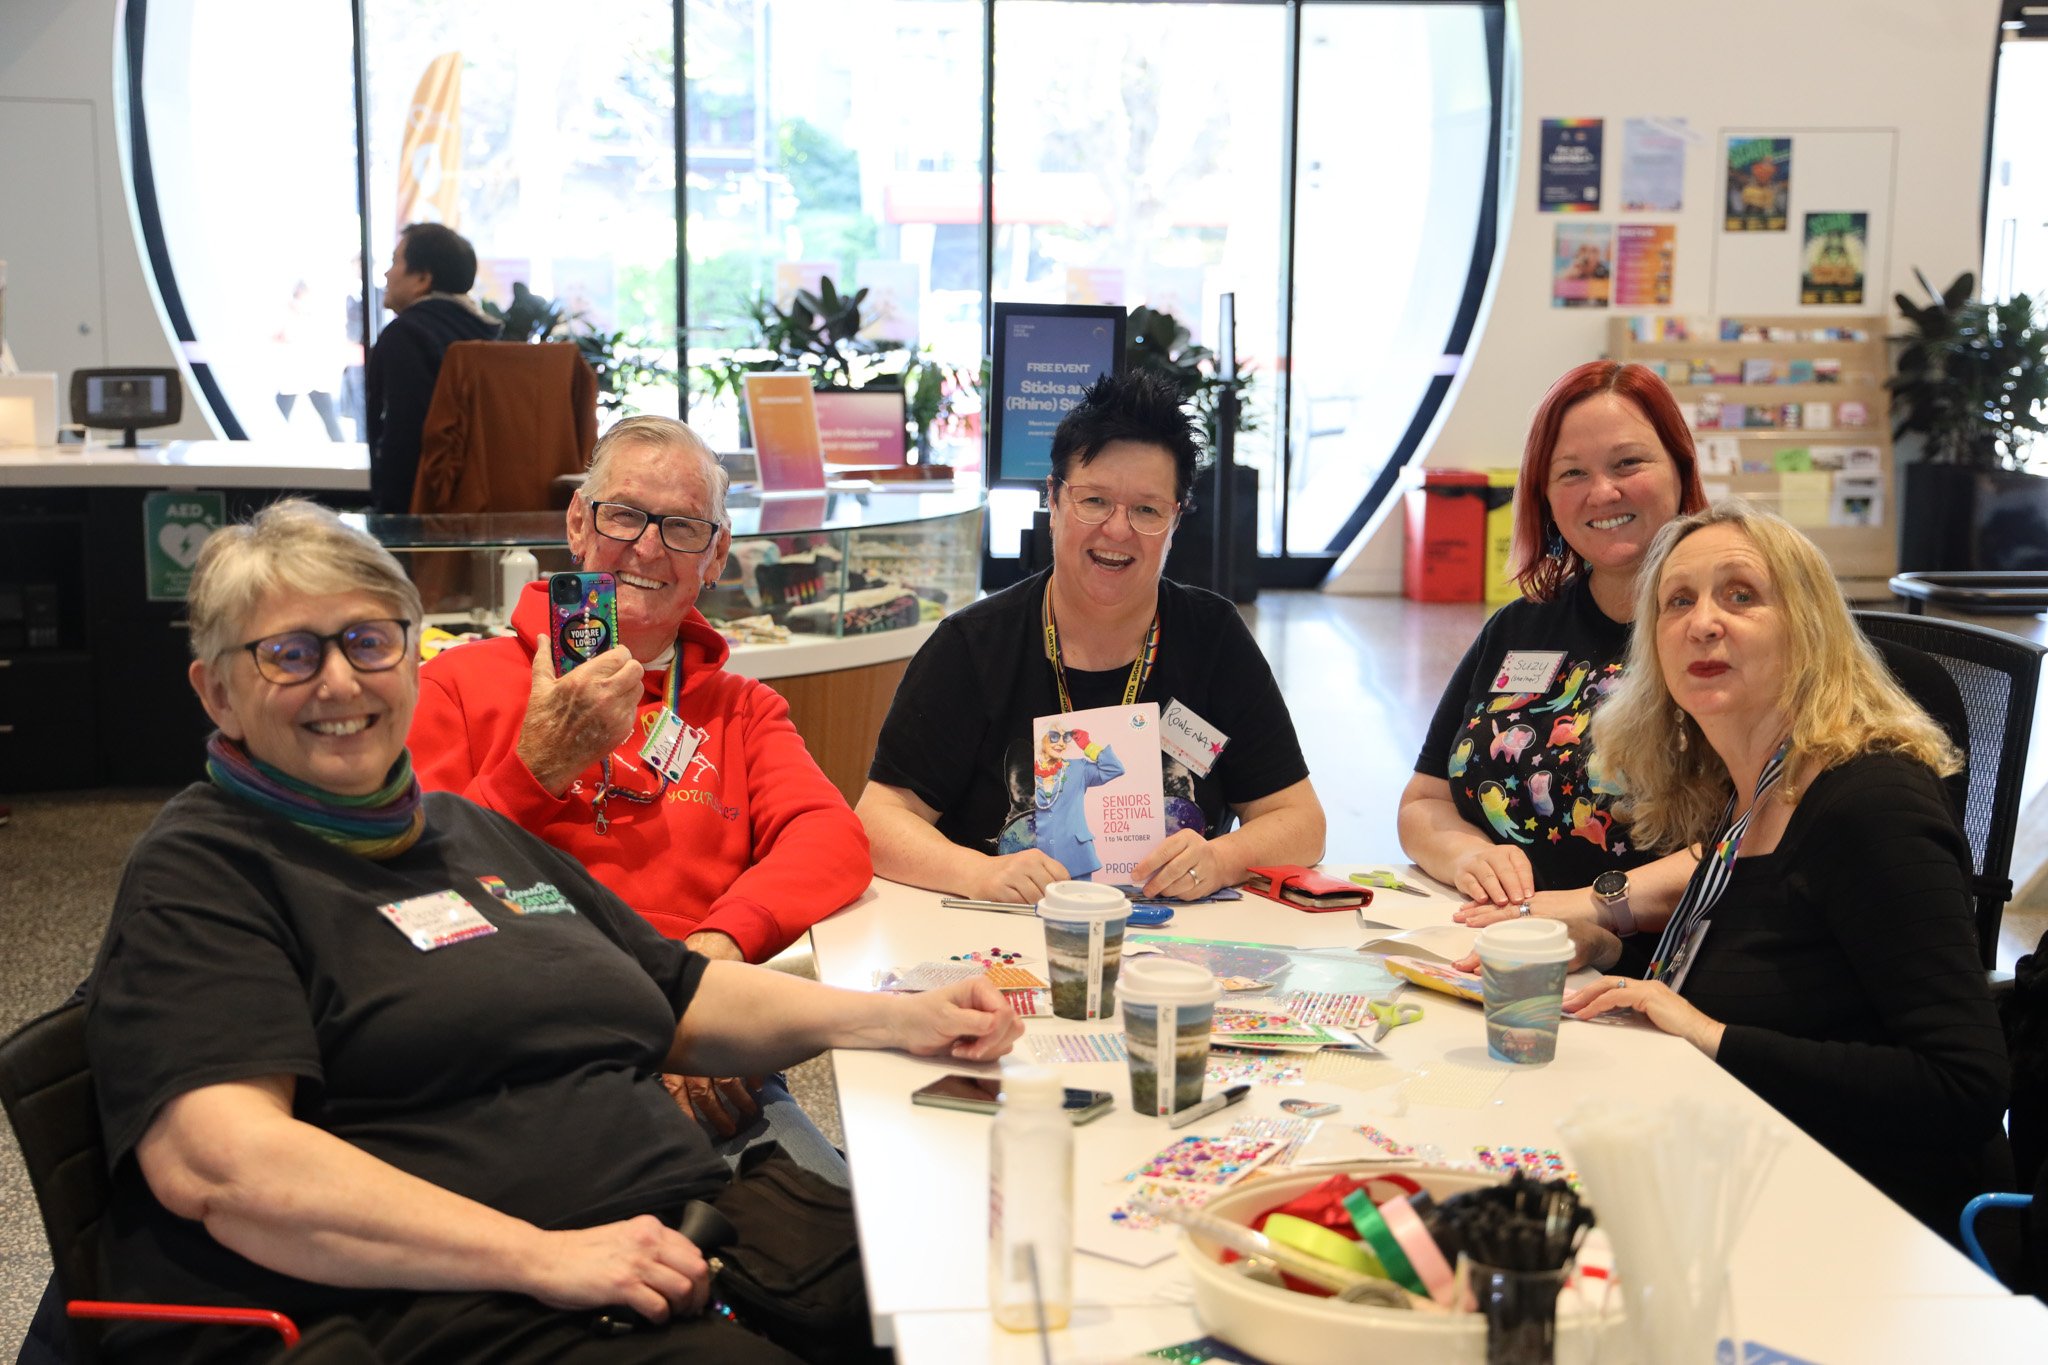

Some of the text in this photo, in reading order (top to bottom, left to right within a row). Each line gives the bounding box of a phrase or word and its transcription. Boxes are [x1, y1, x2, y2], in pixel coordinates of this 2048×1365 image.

[1027, 363, 1091, 374] FREE EVENT
[1020, 380, 1065, 395] Sticks
[1006, 396, 1058, 412] (Rhine)
[166, 503, 204, 517] AED
[571, 630, 586, 638] YOU
[575, 638, 597, 647] LOVED
[1167, 707, 1209, 748] ROWENA
[666, 789, 740, 820] YOURSLF
[1103, 794, 1150, 808] SENIORS
[1103, 807, 1155, 820] FESTIVAL
[1104, 821, 1129, 833] 2024
[1124, 834, 1150, 842] OCTOBER
